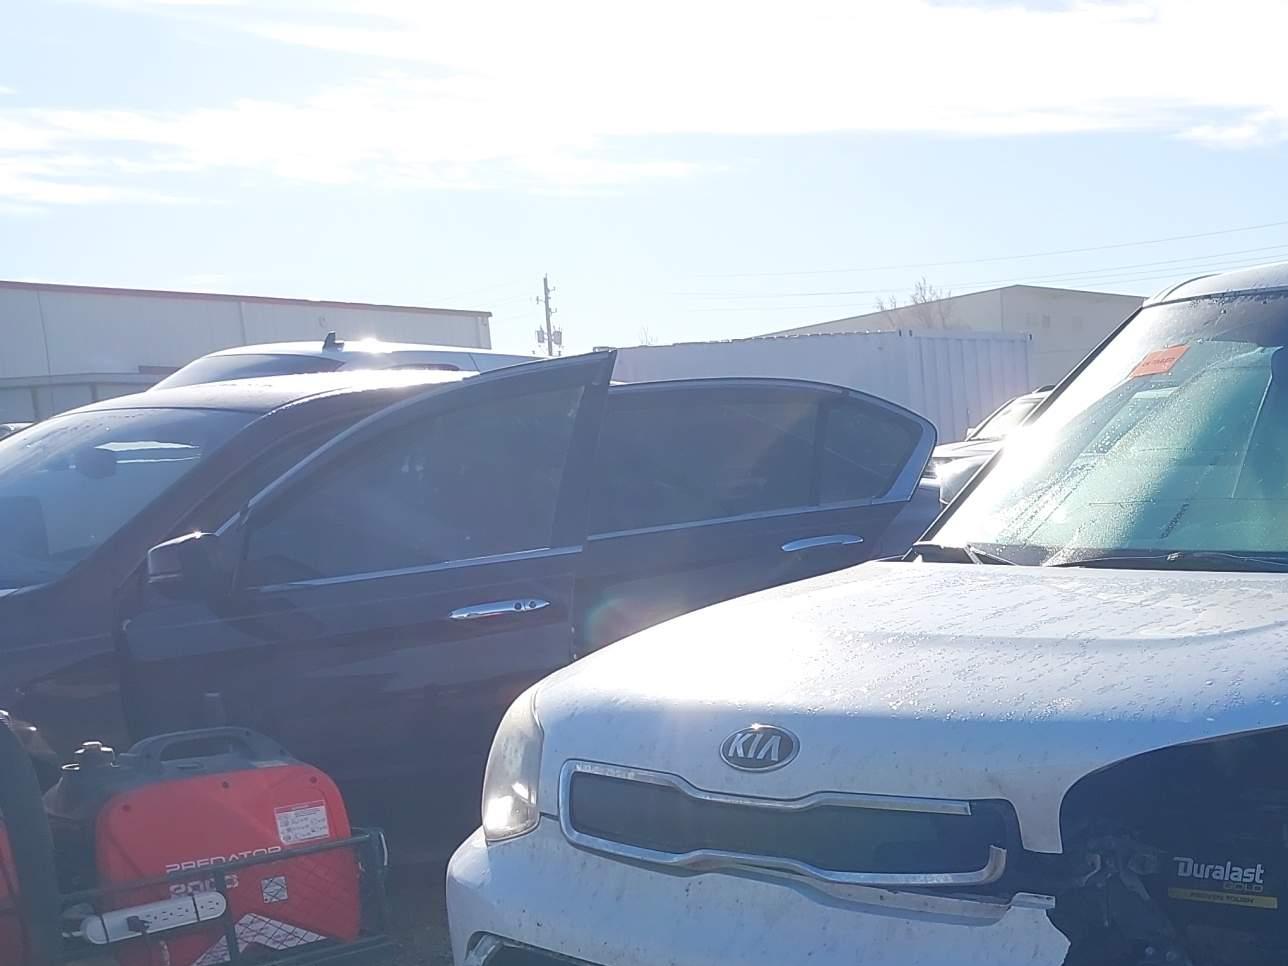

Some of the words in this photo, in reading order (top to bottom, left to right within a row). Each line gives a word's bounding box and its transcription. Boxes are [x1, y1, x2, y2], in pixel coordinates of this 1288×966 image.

[728, 732, 781, 762] KIA
[1173, 857, 1265, 884] Duralast
[1223, 882, 1264, 892] GOLD
